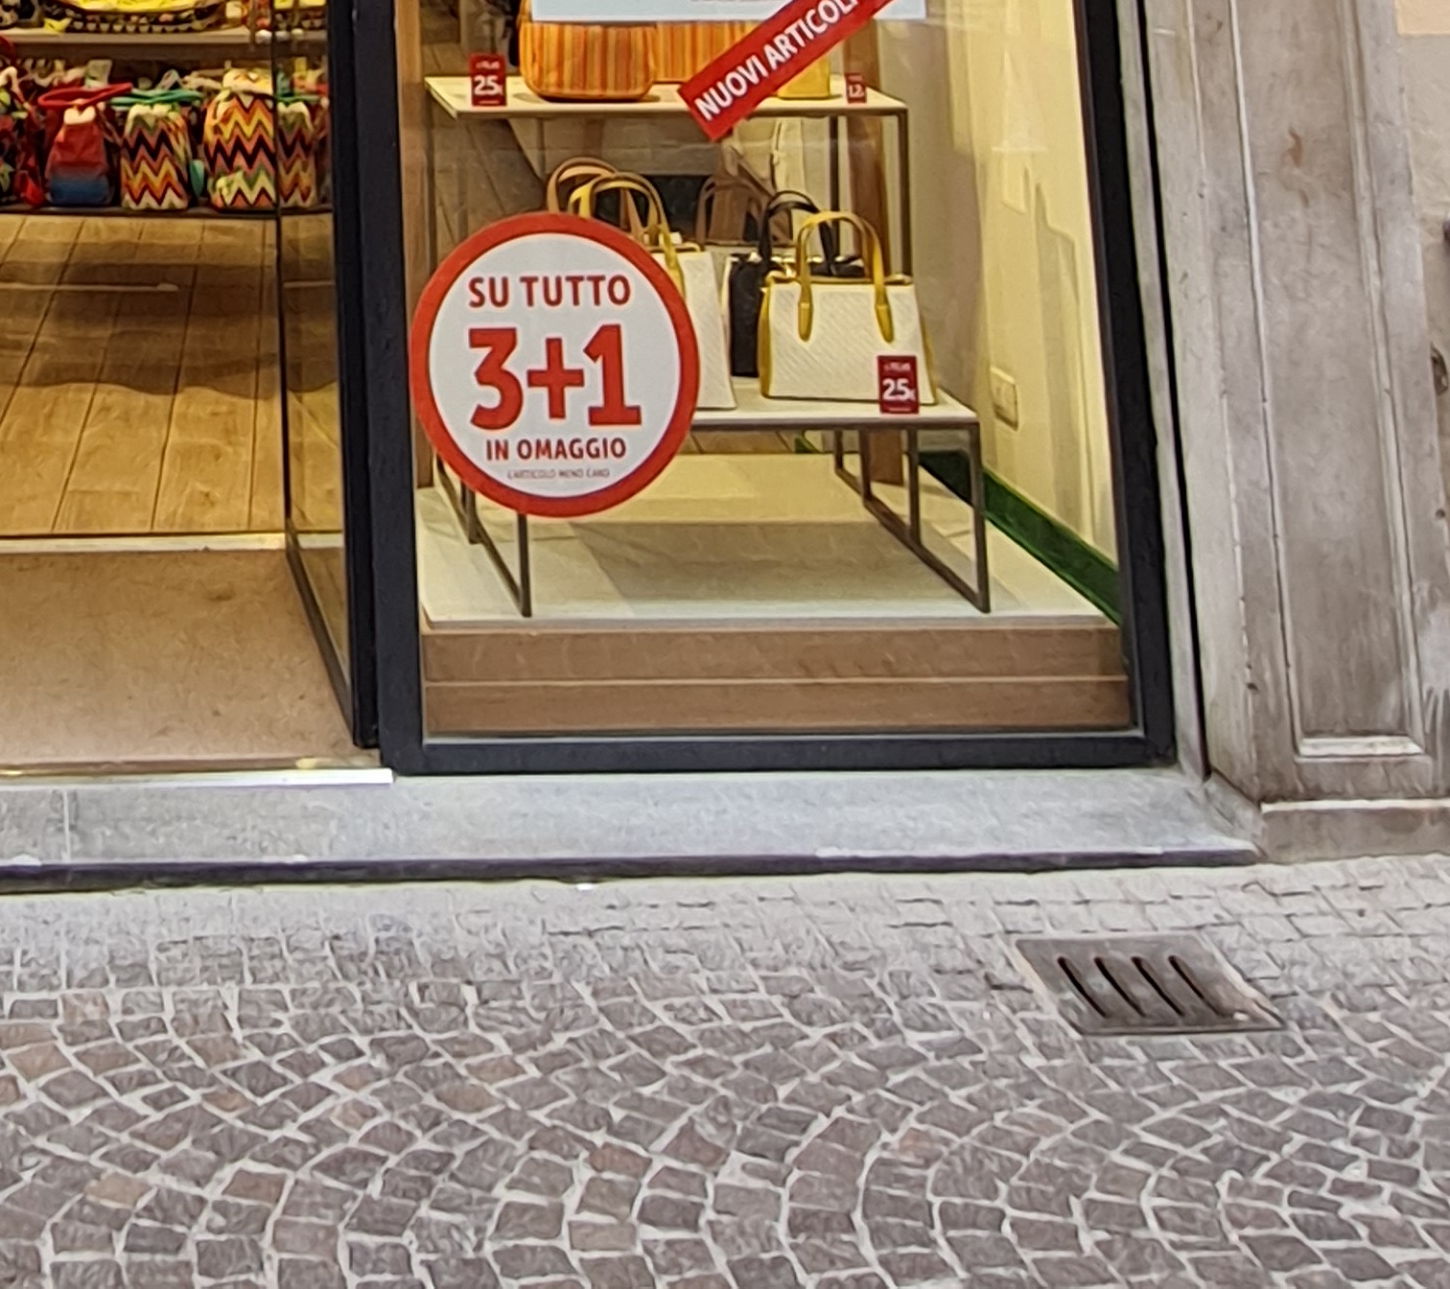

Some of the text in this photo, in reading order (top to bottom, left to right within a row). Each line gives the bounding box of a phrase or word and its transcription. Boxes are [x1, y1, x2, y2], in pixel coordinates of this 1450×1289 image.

[694, 53, 768, 122] NUOVI
[469, 275, 631, 308] SU TUTTO
[468, 324, 642, 430] 3+1
[486, 437, 626, 460] IN OMAGGIO
